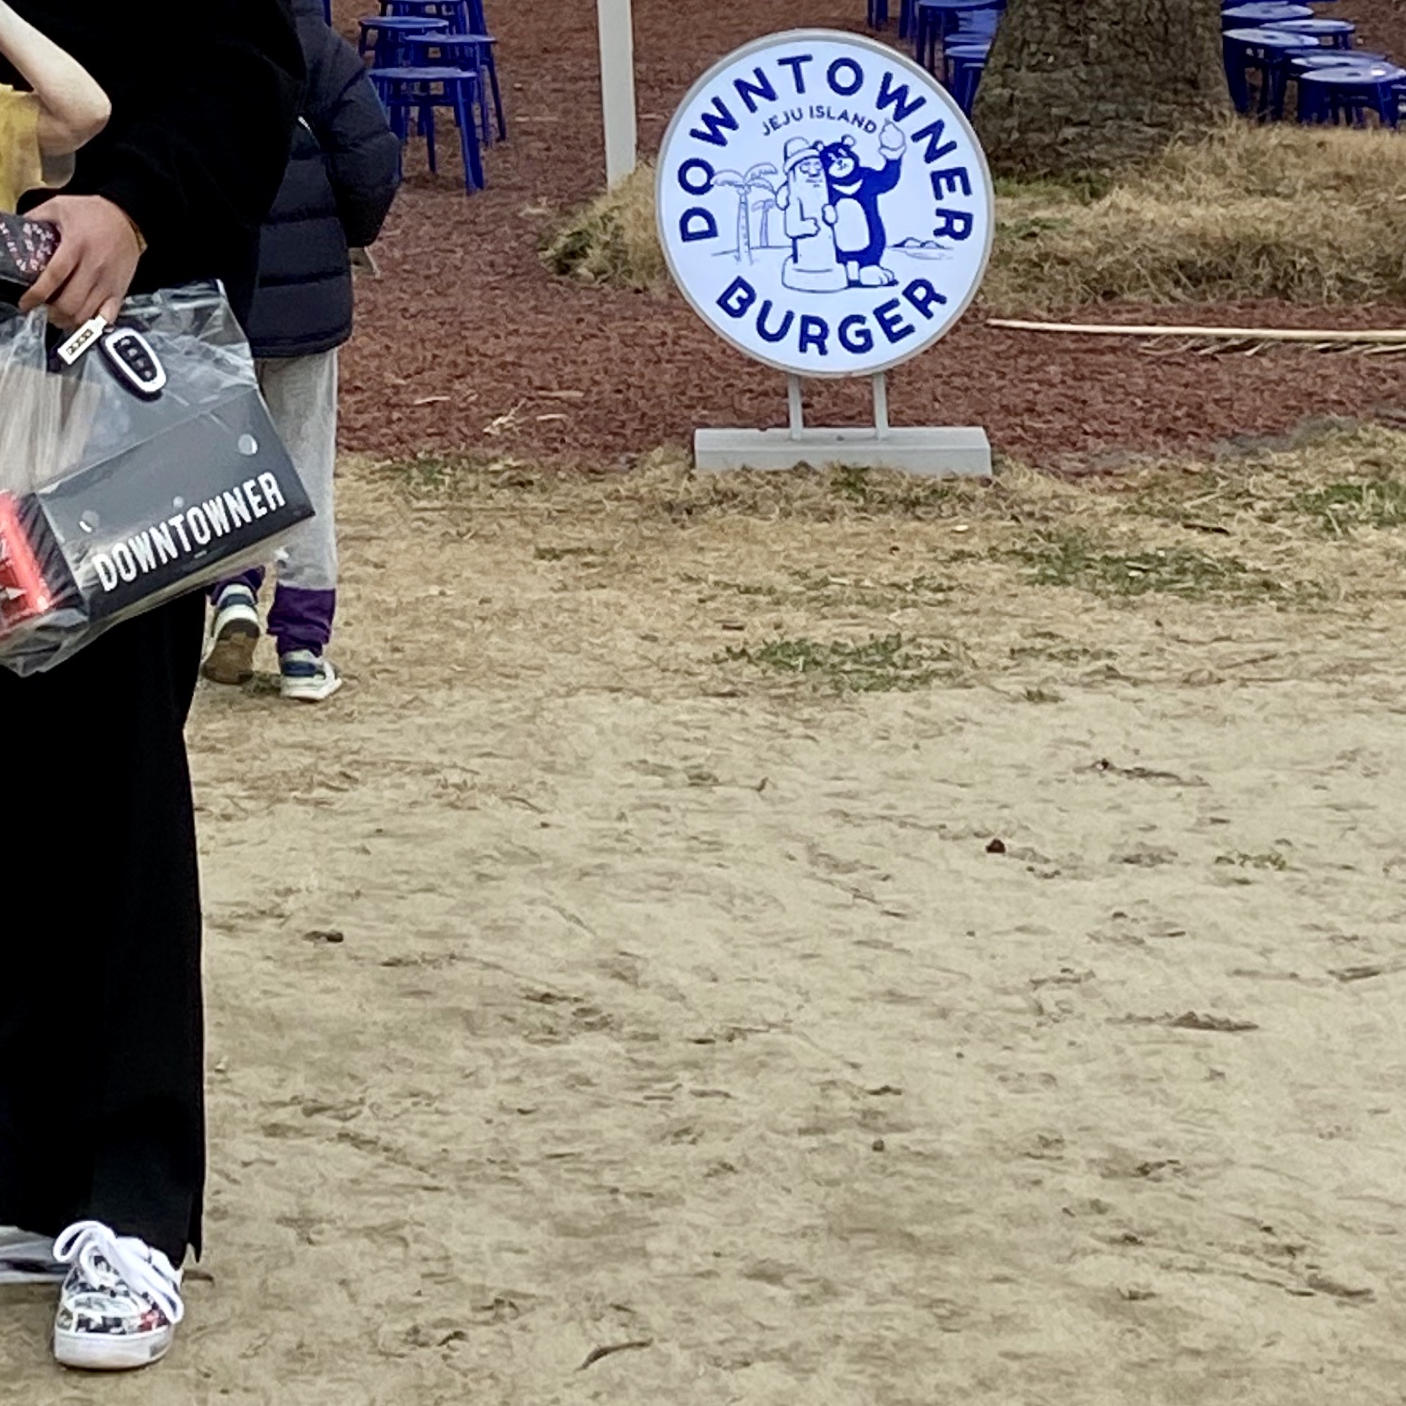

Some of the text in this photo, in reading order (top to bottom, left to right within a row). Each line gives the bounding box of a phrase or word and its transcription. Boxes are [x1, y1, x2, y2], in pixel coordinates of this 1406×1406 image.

[677, 54, 975, 243] DOWNTOWNER
[761, 104, 878, 137] JEJU ISLAND
[716, 276, 947, 357] BURGER
[93, 471, 286, 593] DOWNTOWNER
